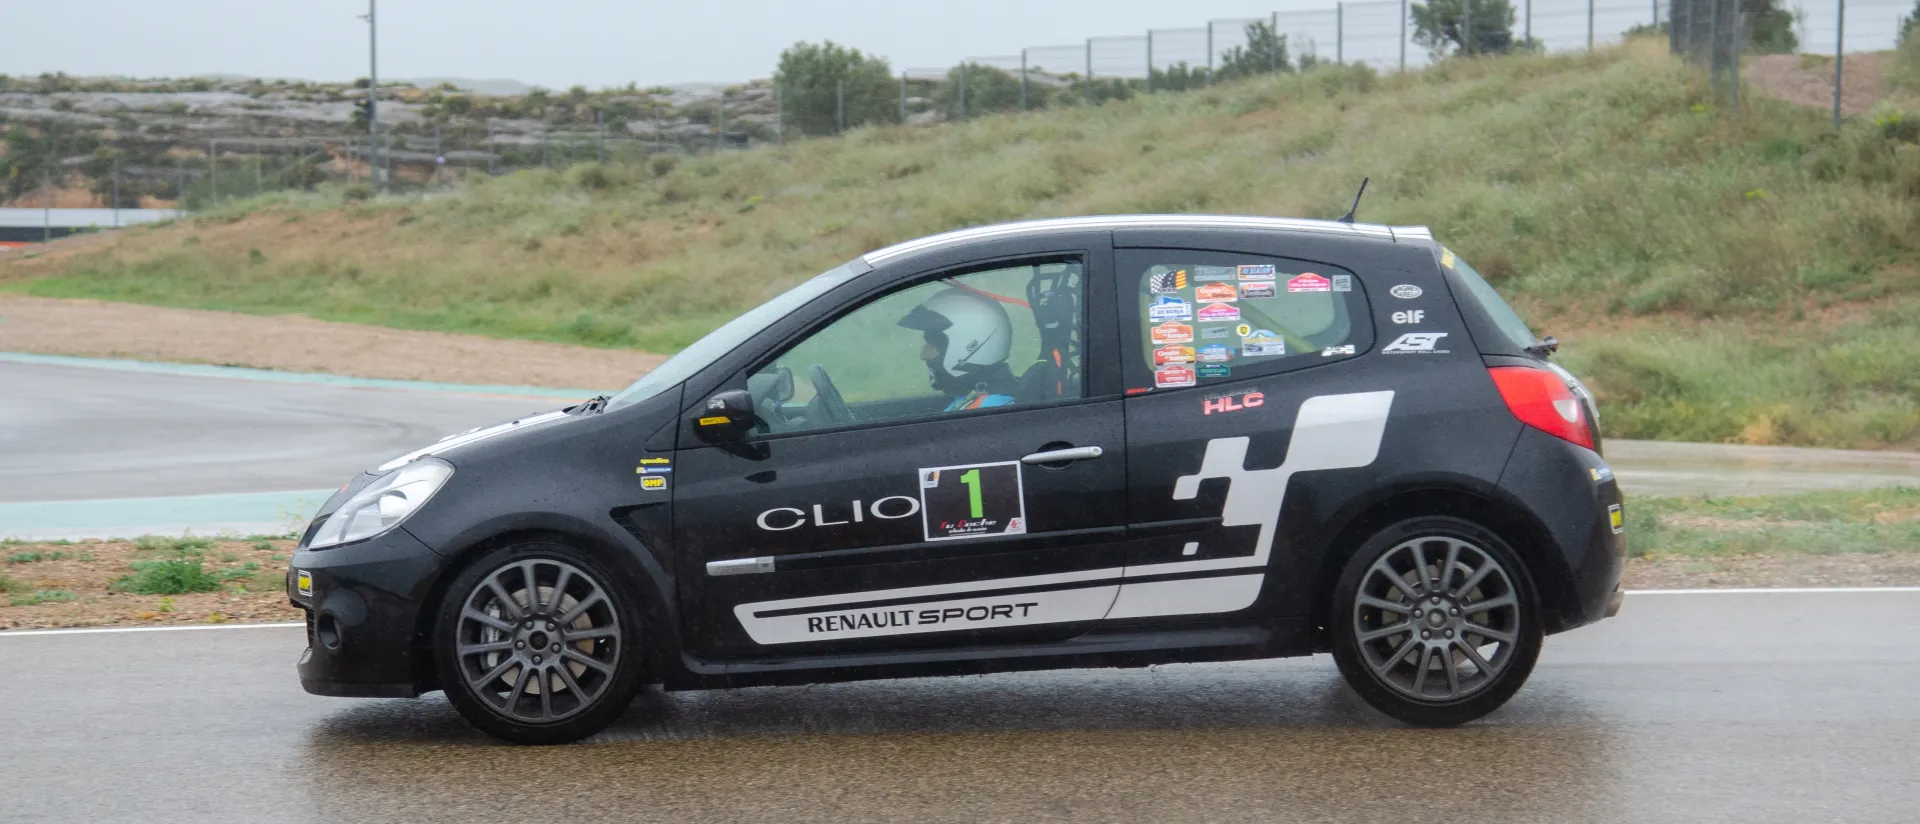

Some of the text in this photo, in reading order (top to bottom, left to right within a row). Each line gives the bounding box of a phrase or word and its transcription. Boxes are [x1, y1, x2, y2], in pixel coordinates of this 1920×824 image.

[1392, 310, 1425, 324] elf
[1382, 333, 1449, 350] AST
[1204, 392, 1264, 415] HLC
[643, 478, 664, 487] OMP
[960, 469, 984, 519] 1
[756, 495, 921, 531] CLIO
[807, 602, 1039, 633] RENAULT SPORT
